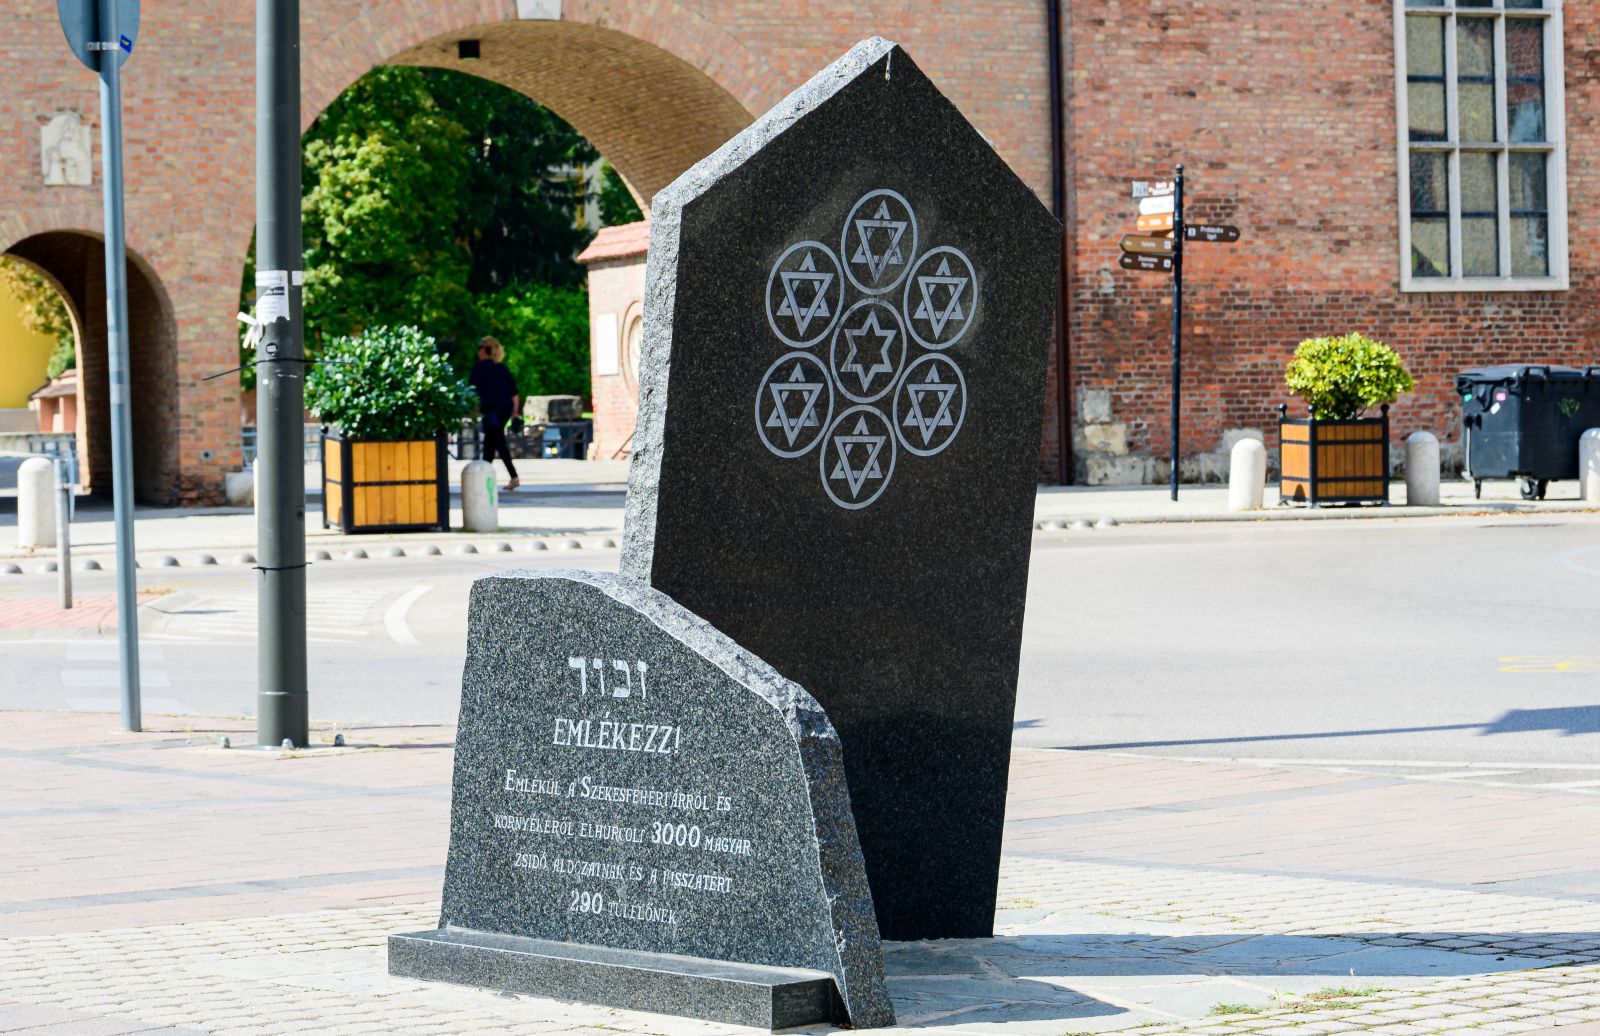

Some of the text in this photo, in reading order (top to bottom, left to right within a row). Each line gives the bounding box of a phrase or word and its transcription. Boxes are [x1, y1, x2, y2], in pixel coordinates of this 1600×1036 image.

[568, 656, 648, 700] זכור
[553, 711, 681, 754] EMLÉKEZZ!
[565, 781, 576, 799] A
[716, 792, 732, 811] ÉS
[651, 821, 701, 848] 3000
[704, 834, 752, 857] MAGYAR
[515, 851, 549, 870] ZSIDÓ
[628, 861, 644, 881] ÉS
[648, 868, 659, 886] A
[569, 887, 604, 915] 290
